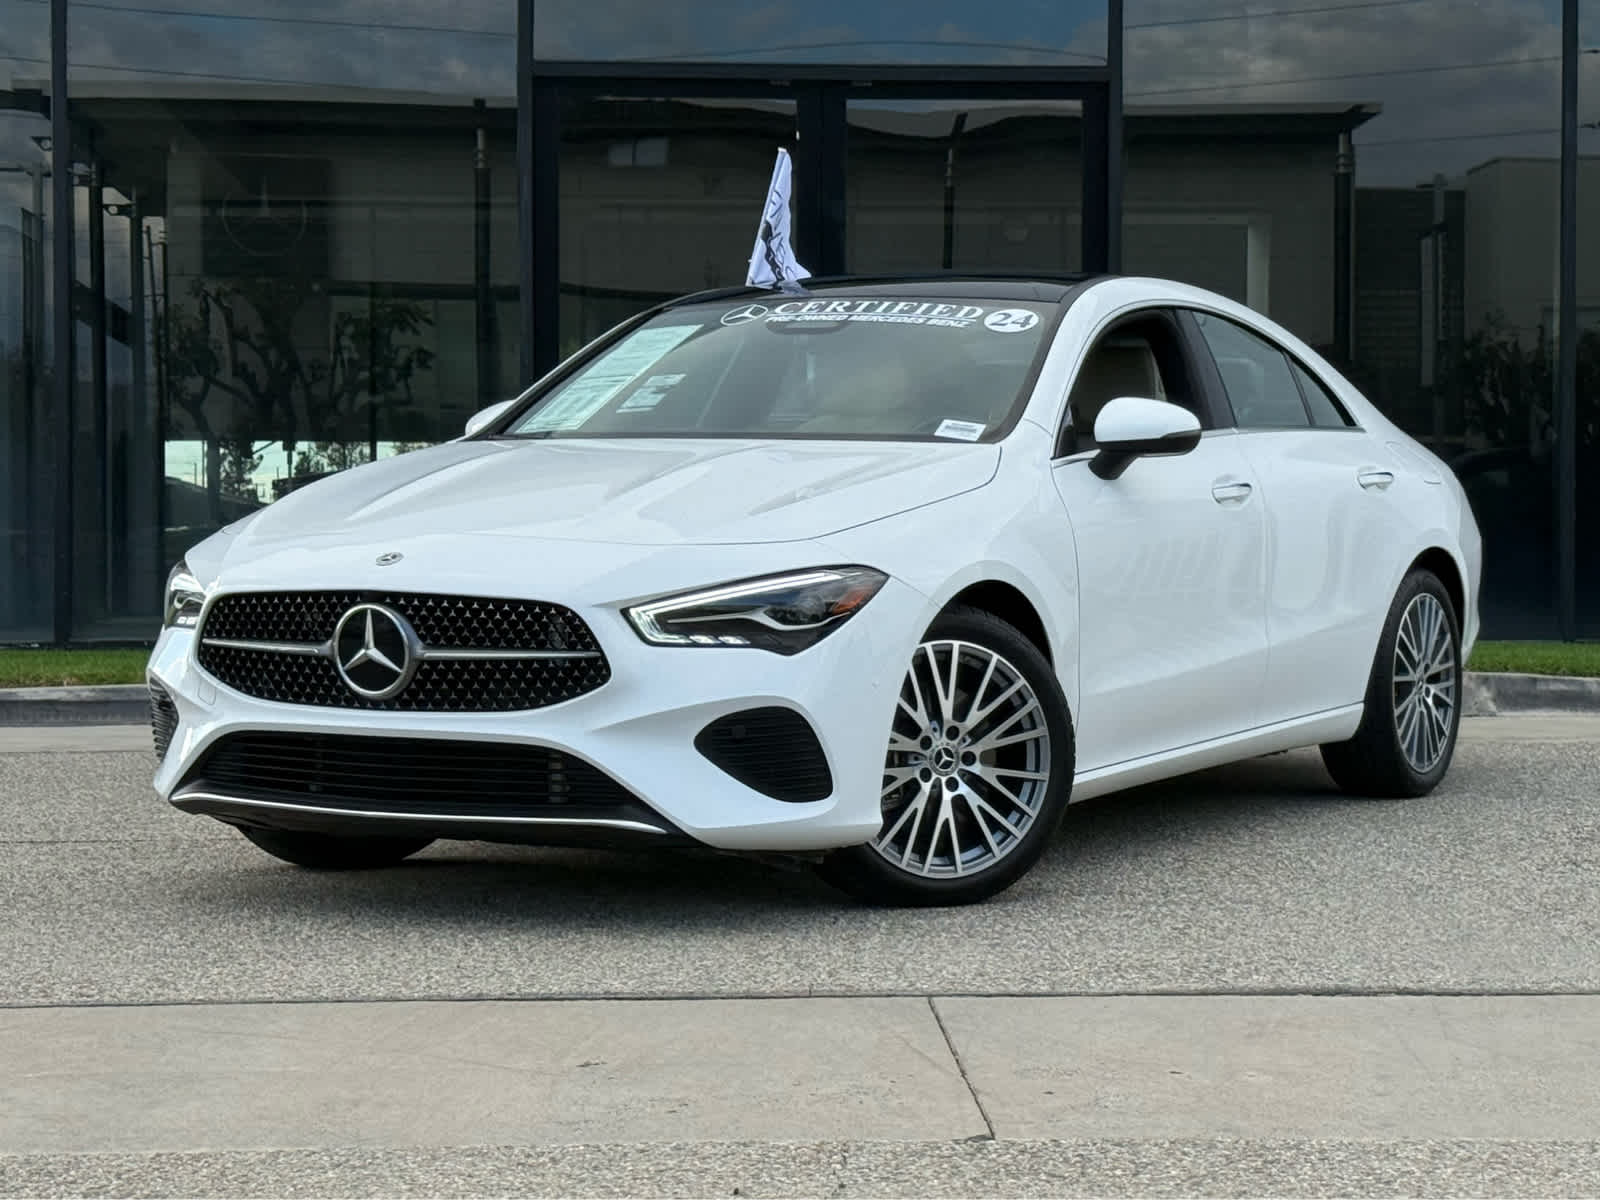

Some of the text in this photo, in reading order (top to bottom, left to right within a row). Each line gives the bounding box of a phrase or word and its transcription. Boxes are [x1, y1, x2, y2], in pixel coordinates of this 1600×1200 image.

[774, 301, 984, 319] CERTIFIED
[848, 315, 927, 324] MERCEDES
[926, 318, 970, 328] BENZ
[989, 312, 1034, 328] 24
